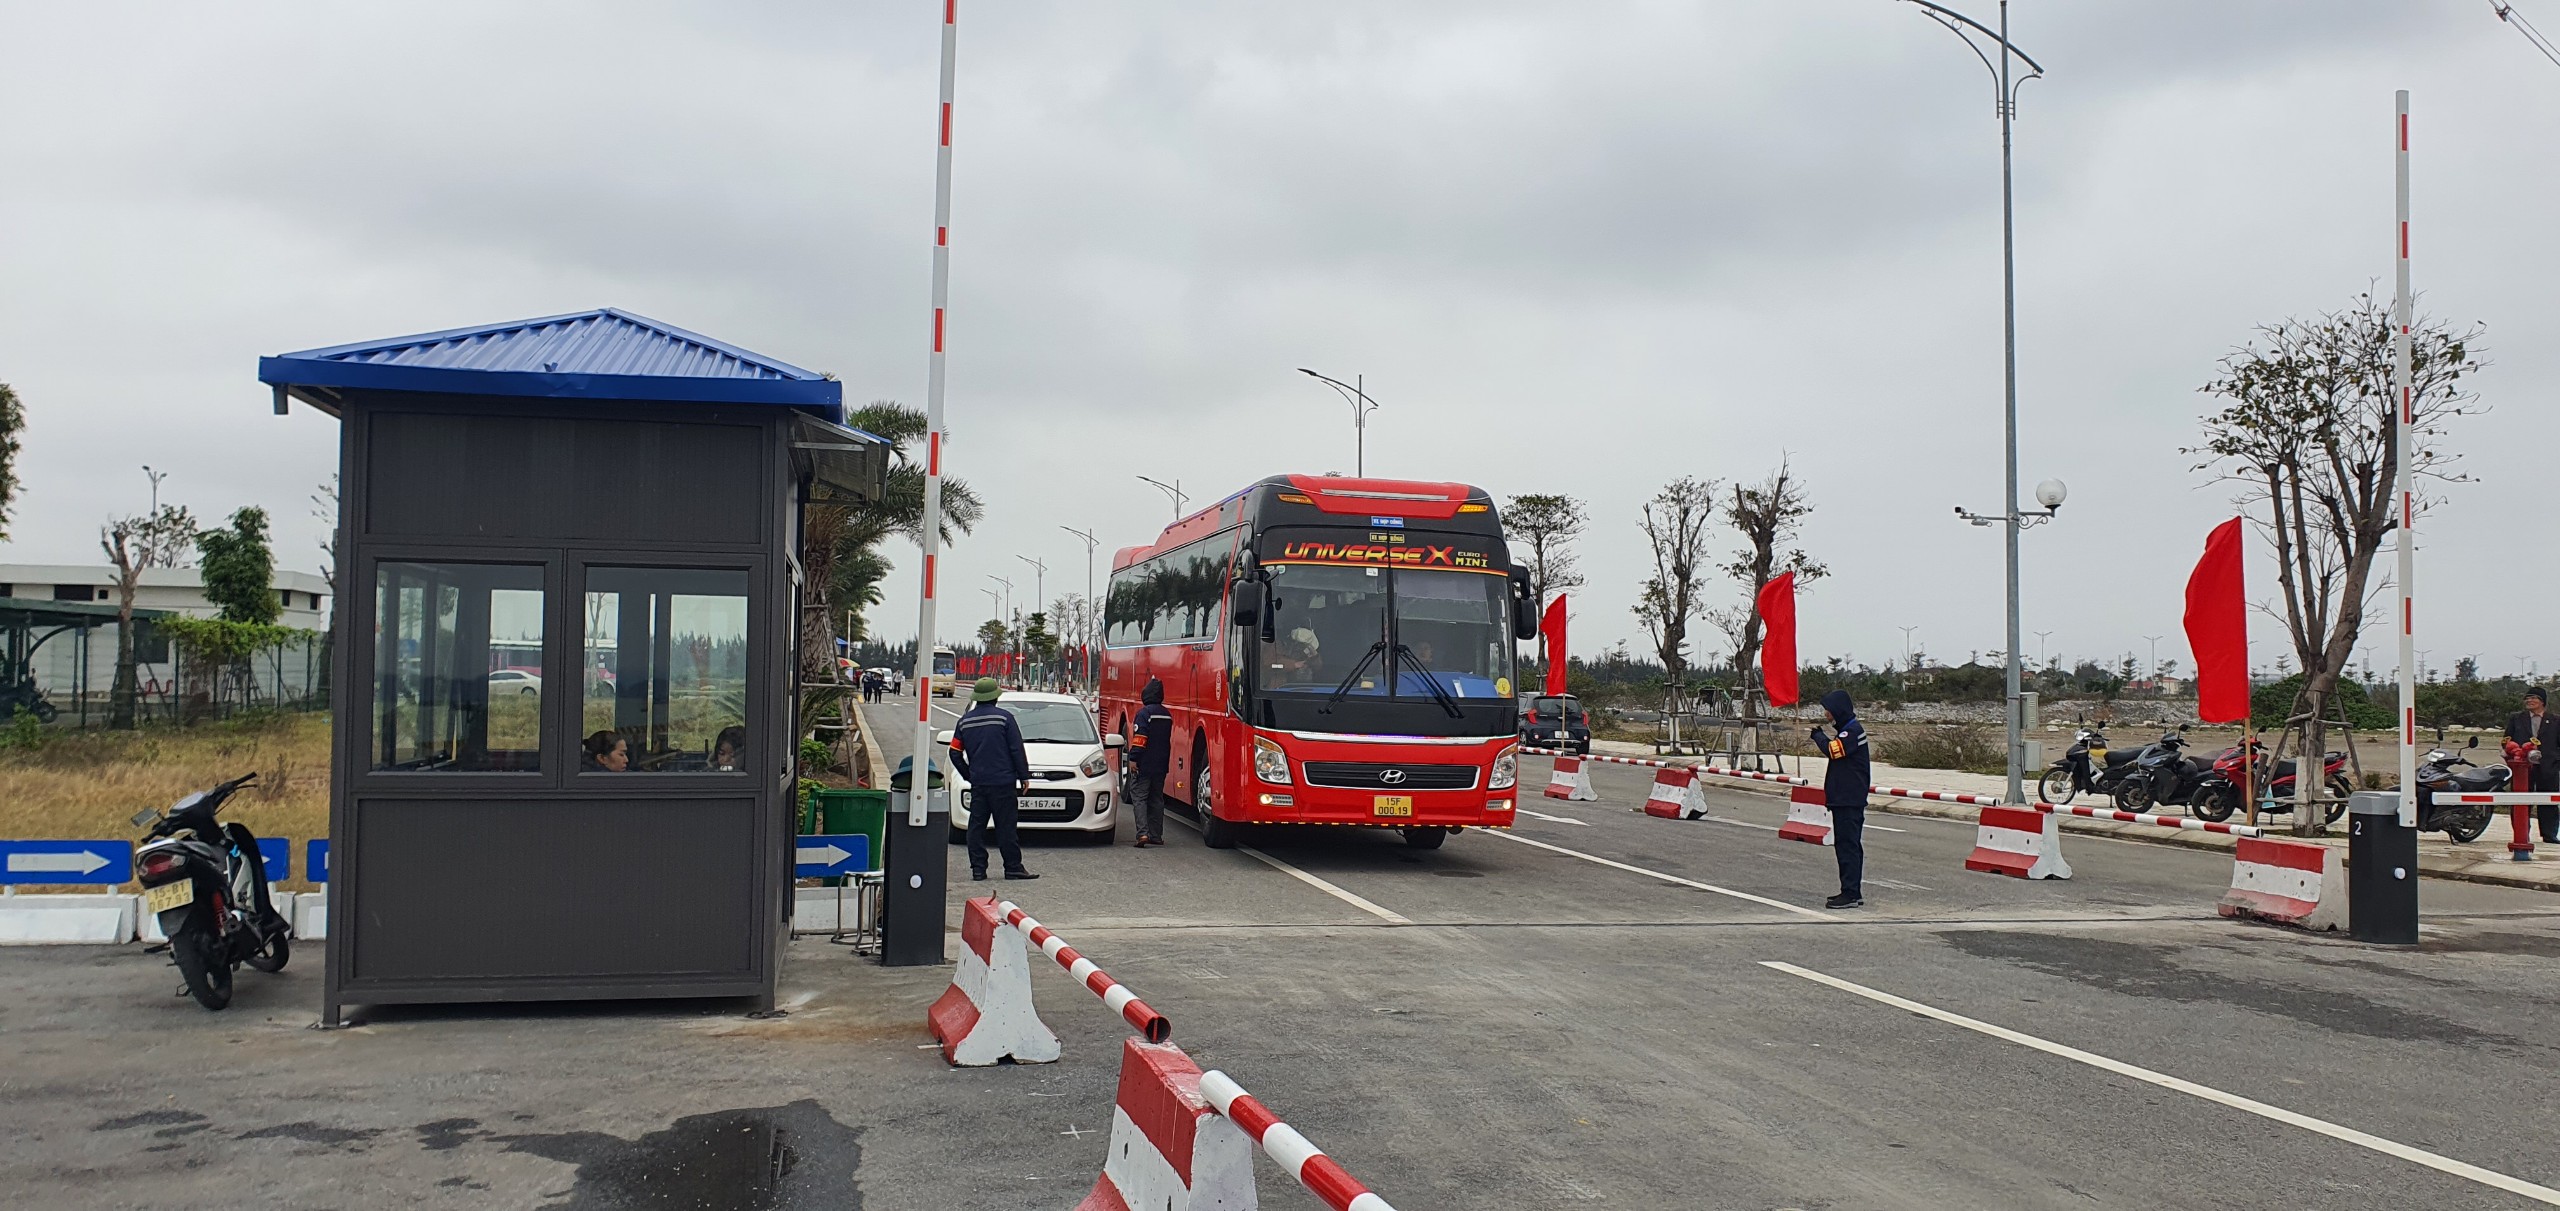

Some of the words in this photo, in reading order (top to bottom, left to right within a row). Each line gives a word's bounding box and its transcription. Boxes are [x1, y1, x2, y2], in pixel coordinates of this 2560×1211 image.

[1284, 542, 1425, 564] UNIVERSE
[1424, 544, 1454, 566] X
[1456, 557, 1488, 568] MINI
[1019, 800, 1061, 808] 5K-167.44
[1386, 797, 1401, 806] 15F
[1378, 806, 1408, 815] 000.19
[2355, 820, 2362, 836] 2
